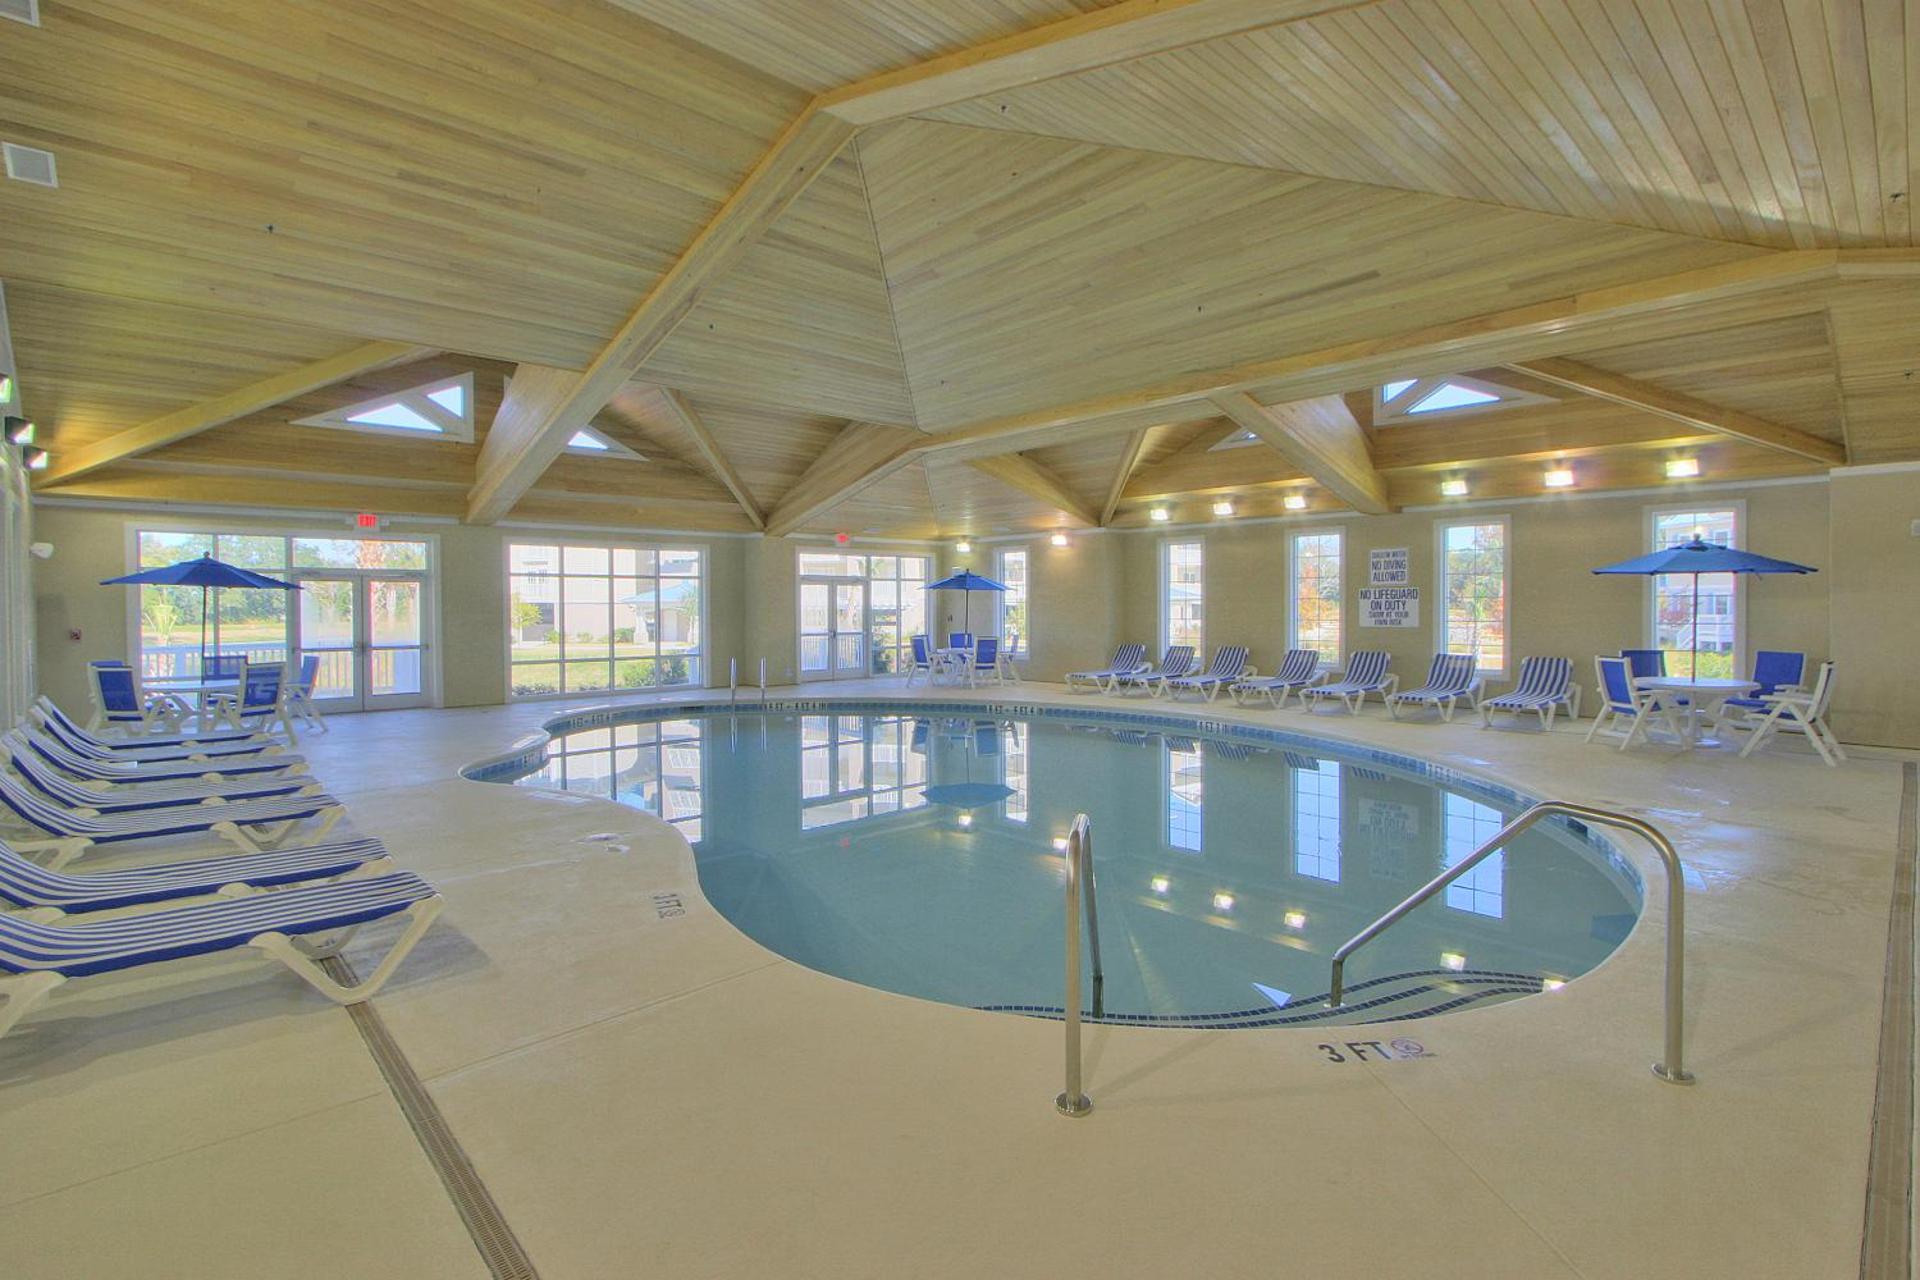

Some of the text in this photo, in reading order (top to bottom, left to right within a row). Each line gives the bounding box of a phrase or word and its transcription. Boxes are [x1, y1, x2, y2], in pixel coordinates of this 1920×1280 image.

[1372, 559, 1406, 570] NO DIVING
[1373, 571, 1406, 582] ALLOWED
[1360, 588, 1418, 600] NO LIFEGUARD
[1370, 600, 1407, 611] ON DUTY
[1318, 1041, 1392, 1063] 3 FT
